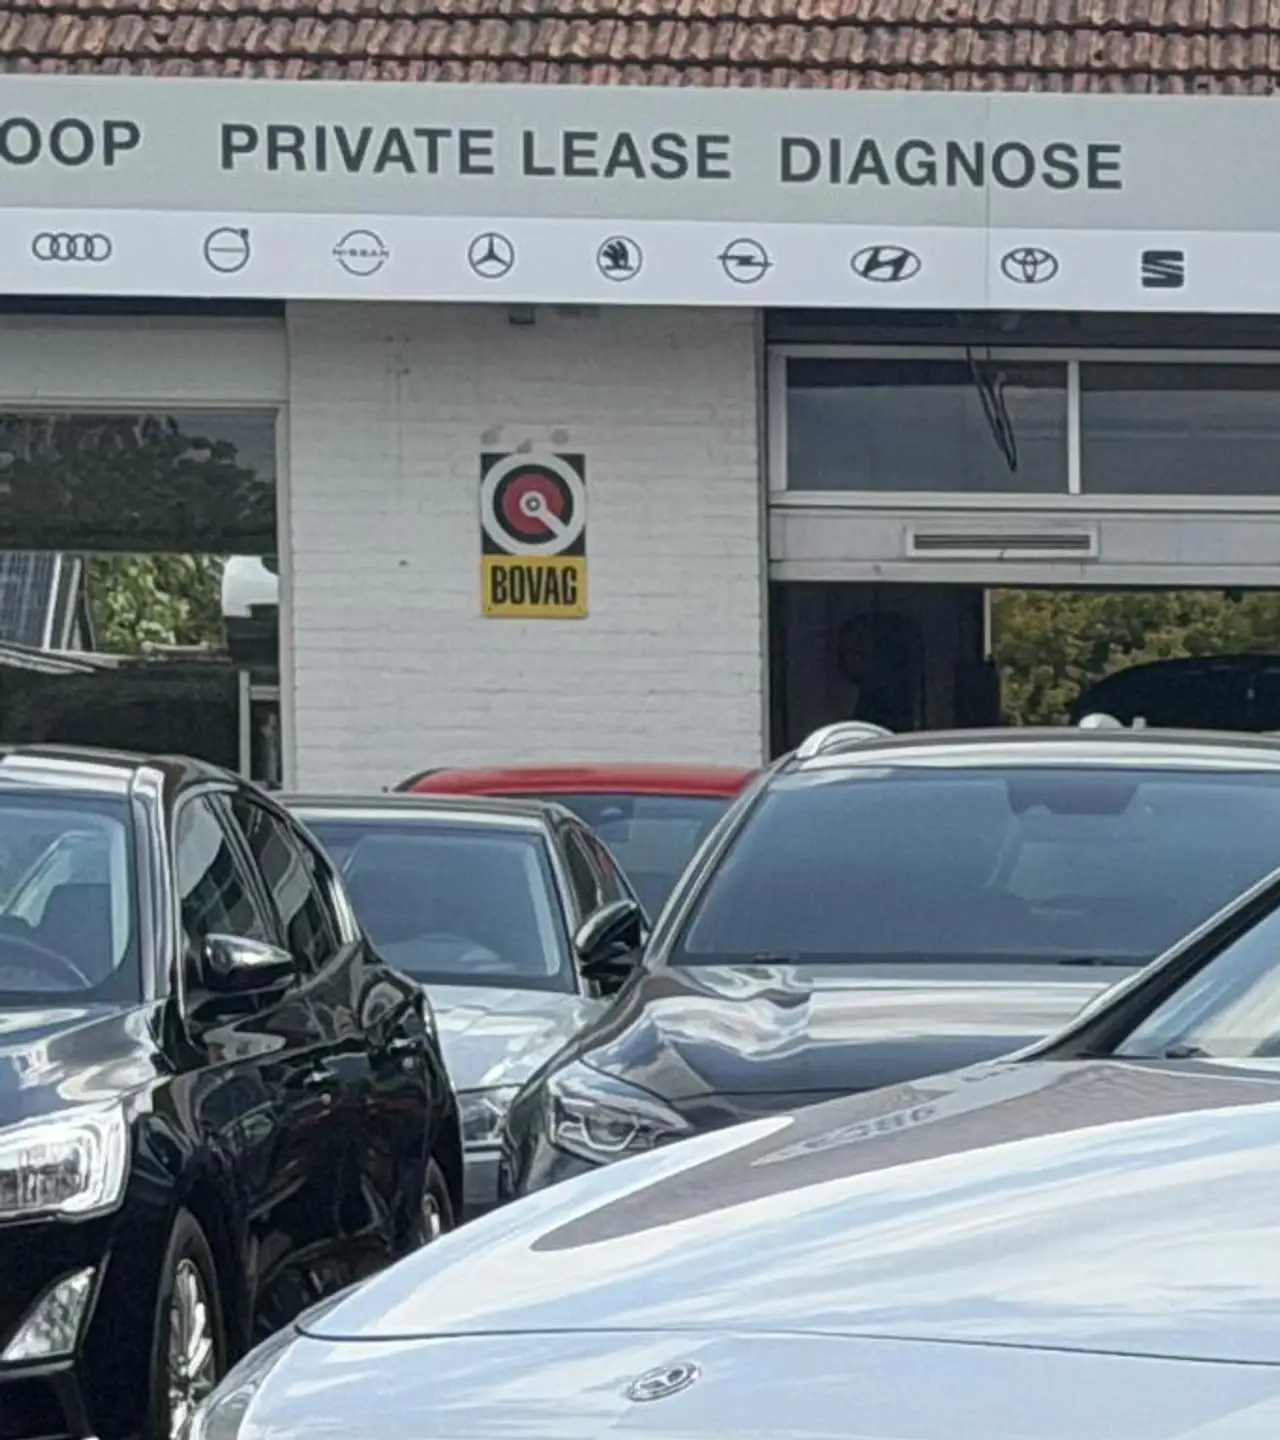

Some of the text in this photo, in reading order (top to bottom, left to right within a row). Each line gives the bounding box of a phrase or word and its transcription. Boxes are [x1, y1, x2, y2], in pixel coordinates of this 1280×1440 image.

[0, 117, 141, 166] OOP
[221, 123, 731, 180] PRIVATE LEASE
[781, 137, 1122, 190] DIAGNOSE
[491, 565, 578, 605] BOVAG
